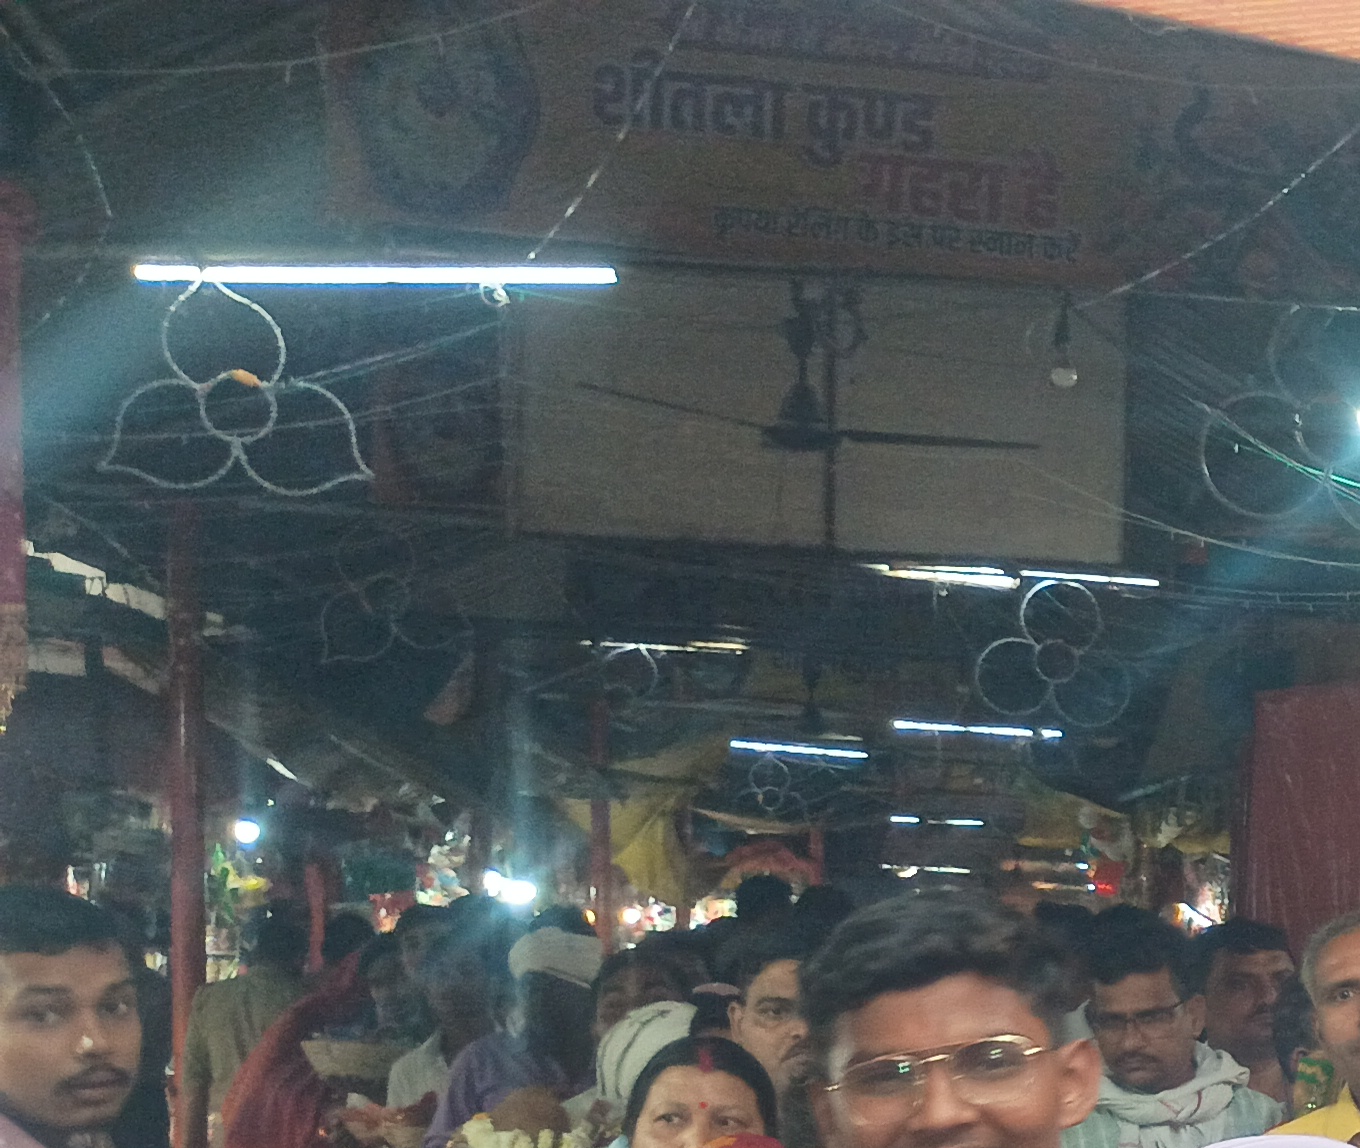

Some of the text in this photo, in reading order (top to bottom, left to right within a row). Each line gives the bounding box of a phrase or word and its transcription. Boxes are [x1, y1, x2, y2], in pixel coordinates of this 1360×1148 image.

[592, 46, 943, 169] शीतला कुण्ड
[713, 204, 778, 240] कृपया
[857, 147, 1064, 228] गहरा है
